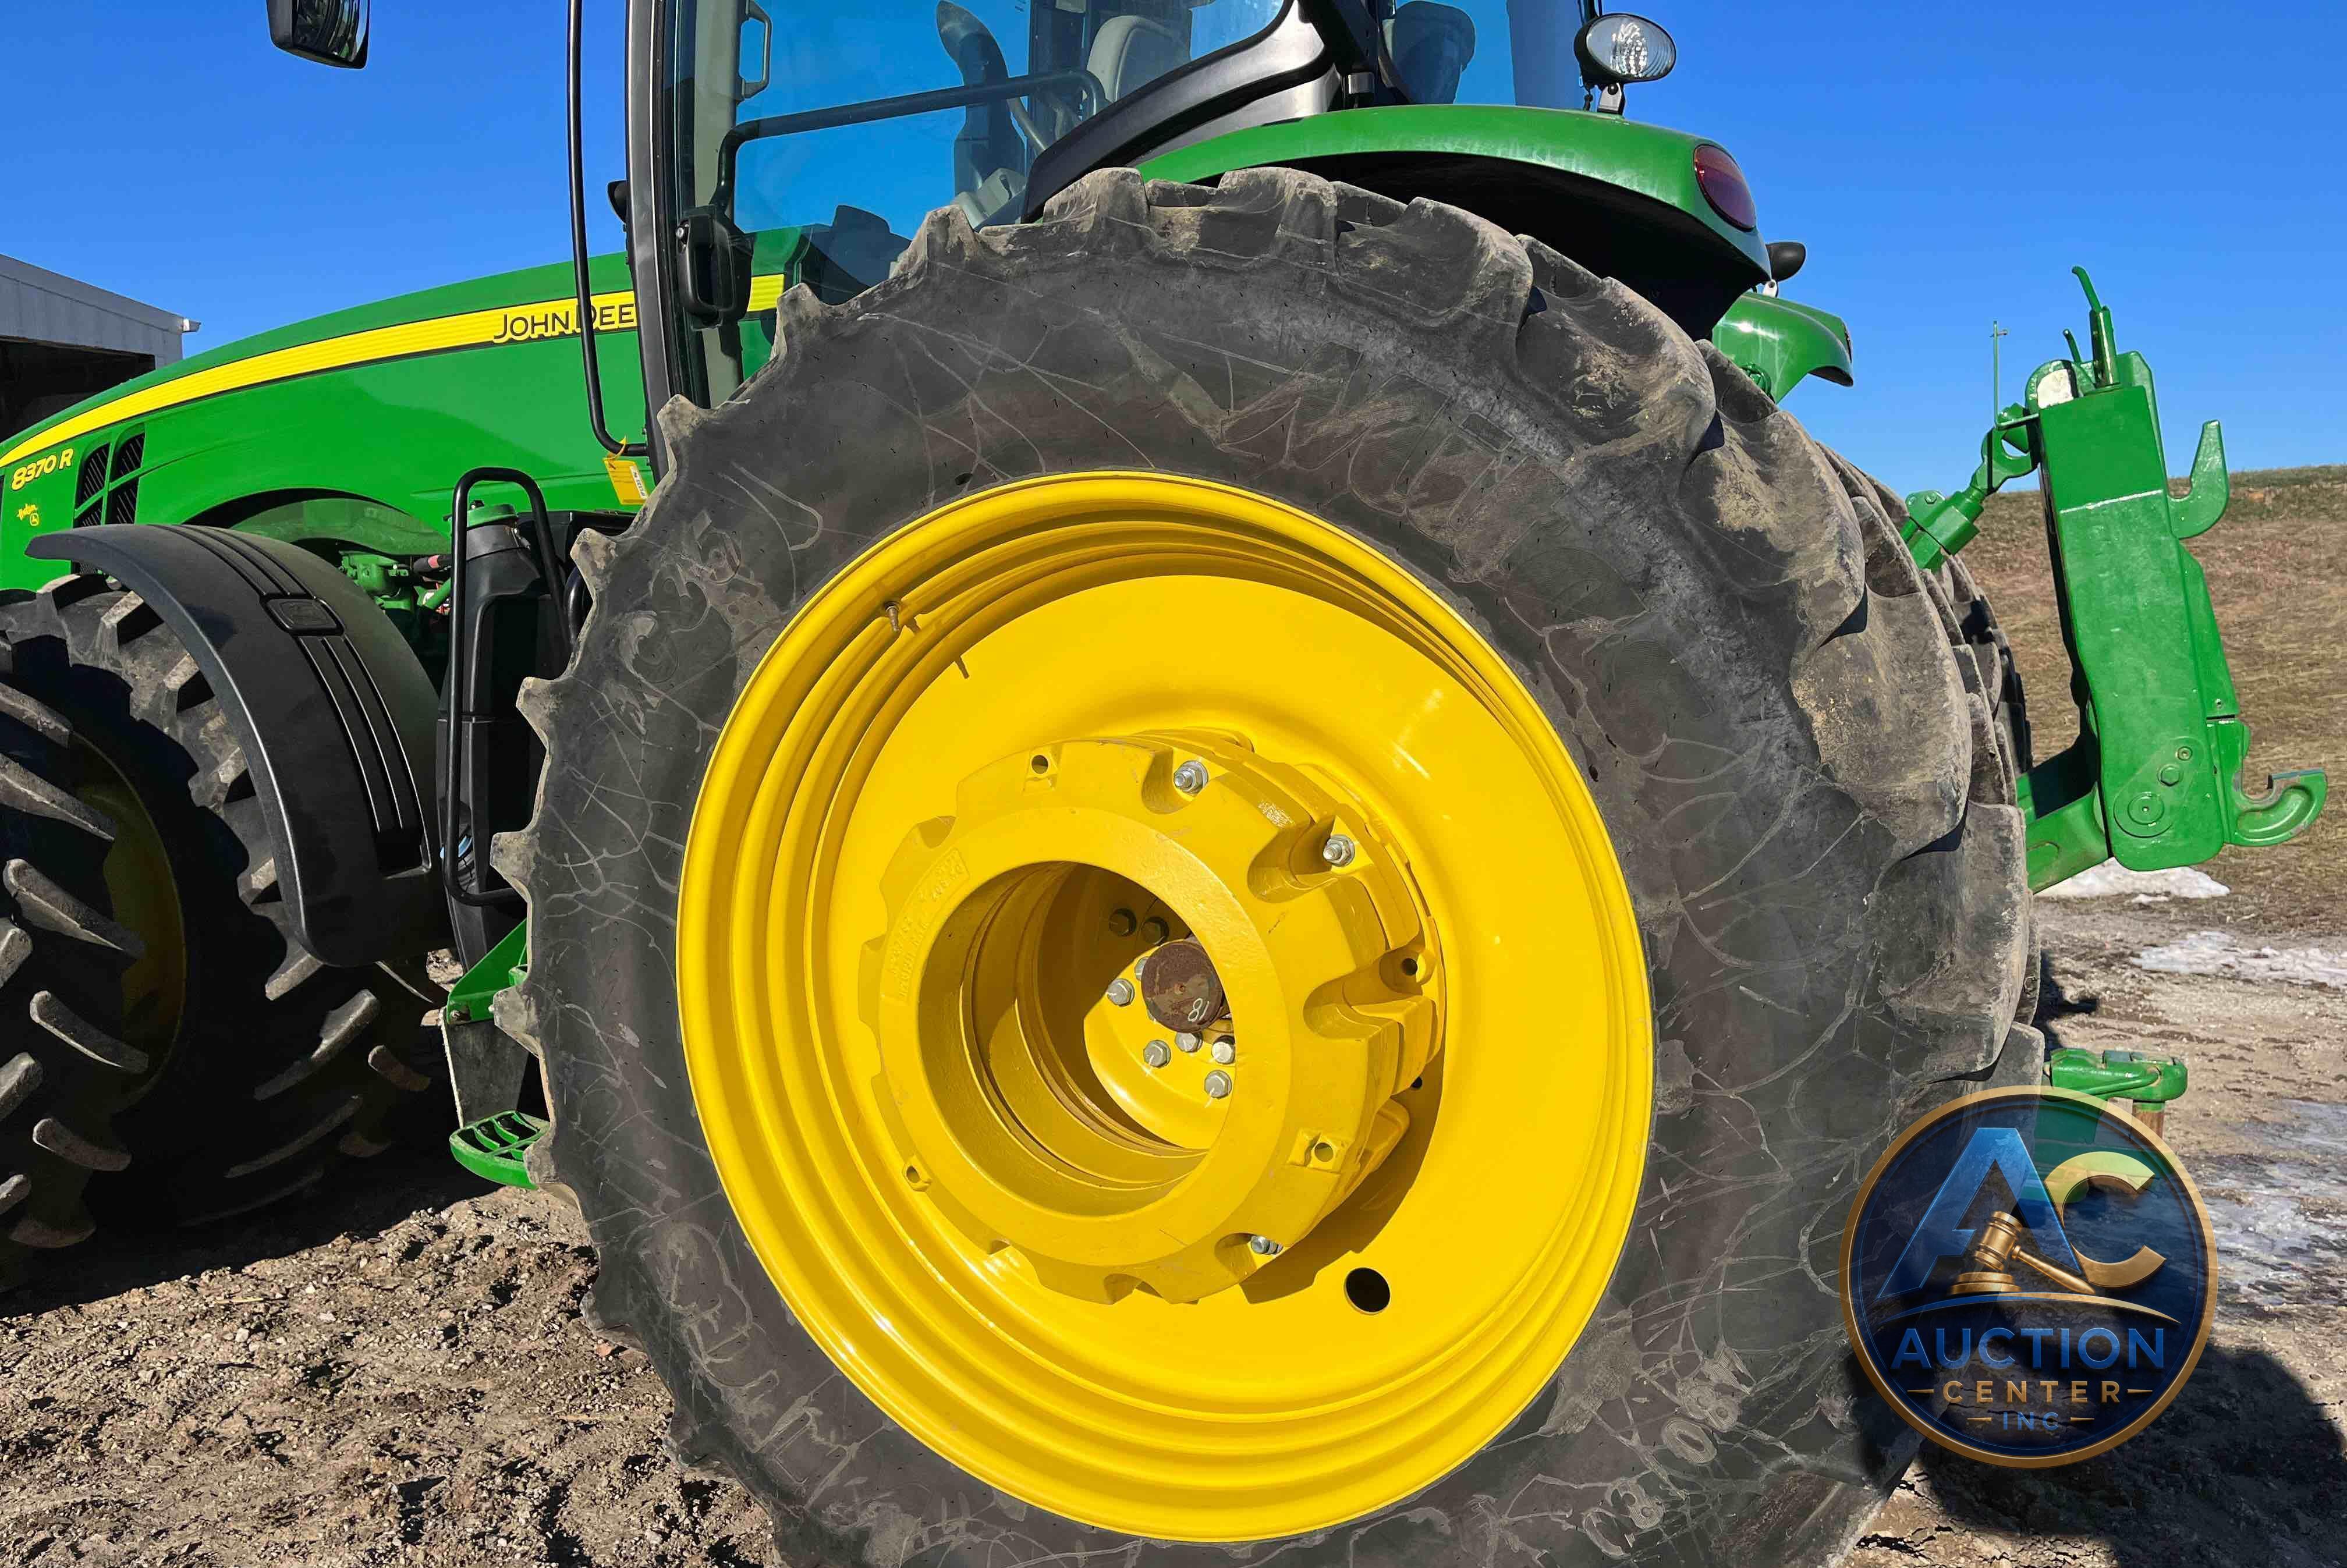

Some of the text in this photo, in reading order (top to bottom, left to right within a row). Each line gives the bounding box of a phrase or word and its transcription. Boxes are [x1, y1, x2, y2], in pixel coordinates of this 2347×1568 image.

[493, 310, 570, 340] JOHN
[11, 448, 74, 490] 8370 R
